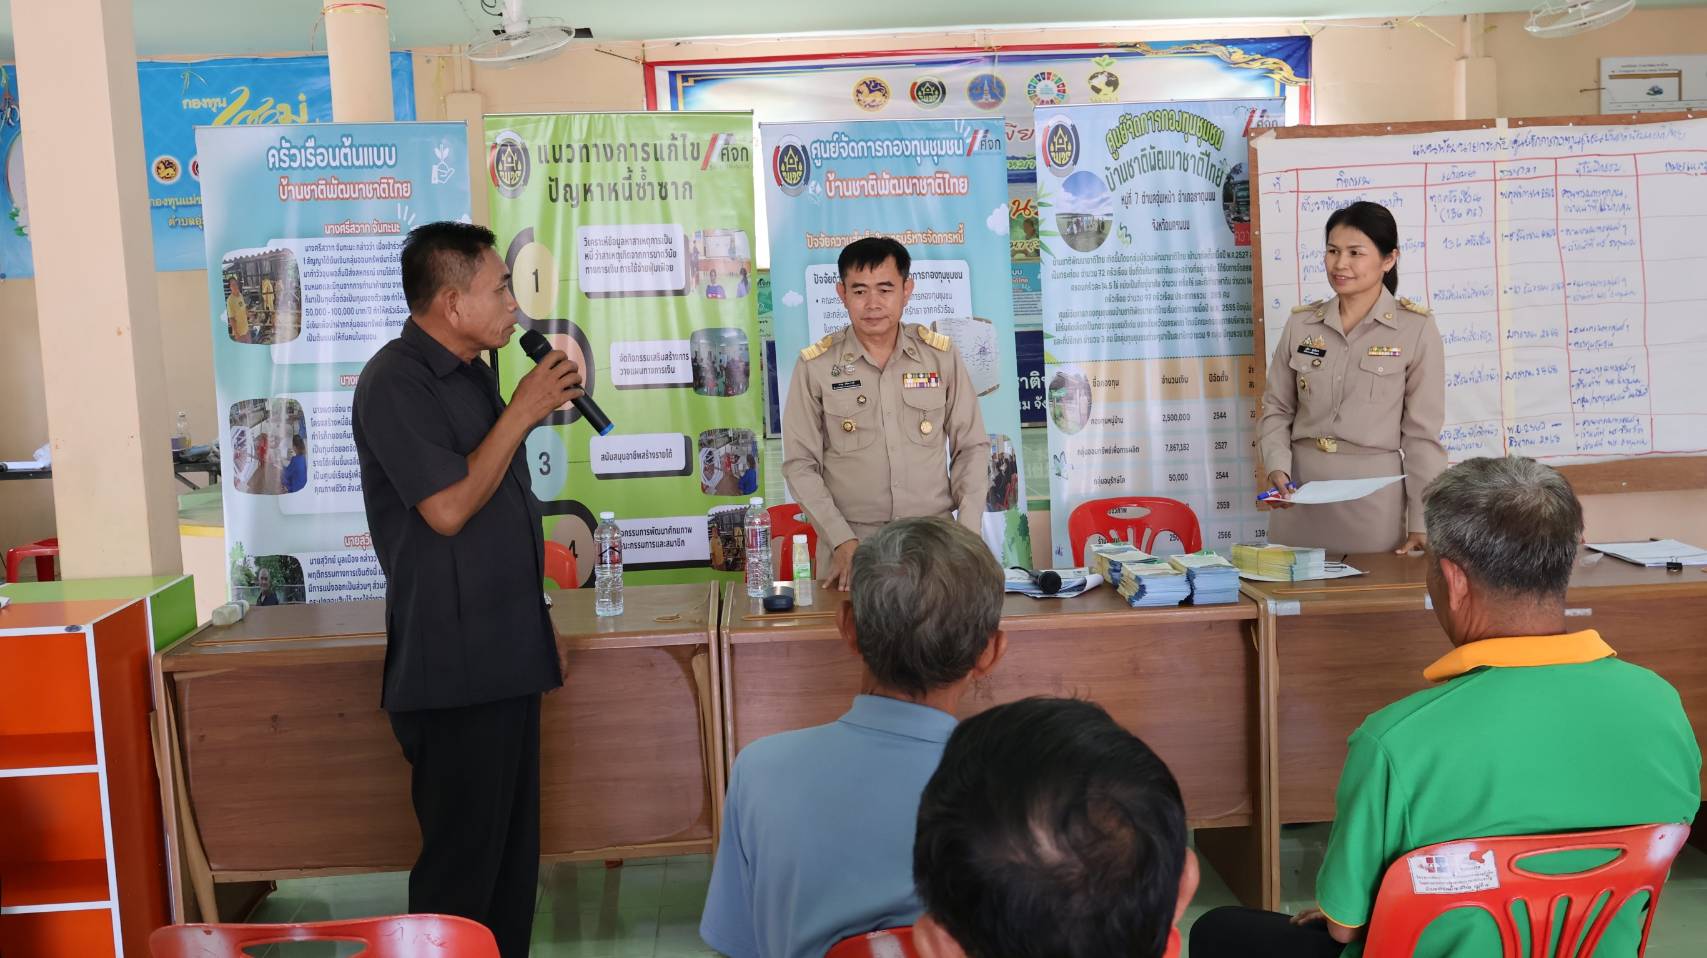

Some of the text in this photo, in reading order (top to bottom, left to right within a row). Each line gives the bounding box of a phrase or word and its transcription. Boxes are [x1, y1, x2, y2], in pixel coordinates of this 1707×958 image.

[537, 133, 700, 164] แนวทางการแก้ไข
[1105, 108, 1225, 161] ศูนย์จัดการกองทุนชุมชน
[266, 135, 398, 170] ครัวเรือนต้นแบบ
[811, 133, 963, 167] ศูนย์จัดการกองทุนชุมชน
[1105, 144, 1225, 192] บ้านชาติพัฒนาชาติไทย
[279, 175, 412, 201] บ้านชาติพัฒนาชาติไทย
[549, 167, 693, 208] ปัญหาหนี้ซ้ำซาก
[826, 172, 968, 198] บ้านชาติพัฒนาชาติไทย
[532, 269, 539, 293] 1
[538, 452, 551, 476] 3
[600, 448, 673, 464] สนับสนุนอาชีพสร้างรายได้
[1168, 473, 1189, 482] 50,000
